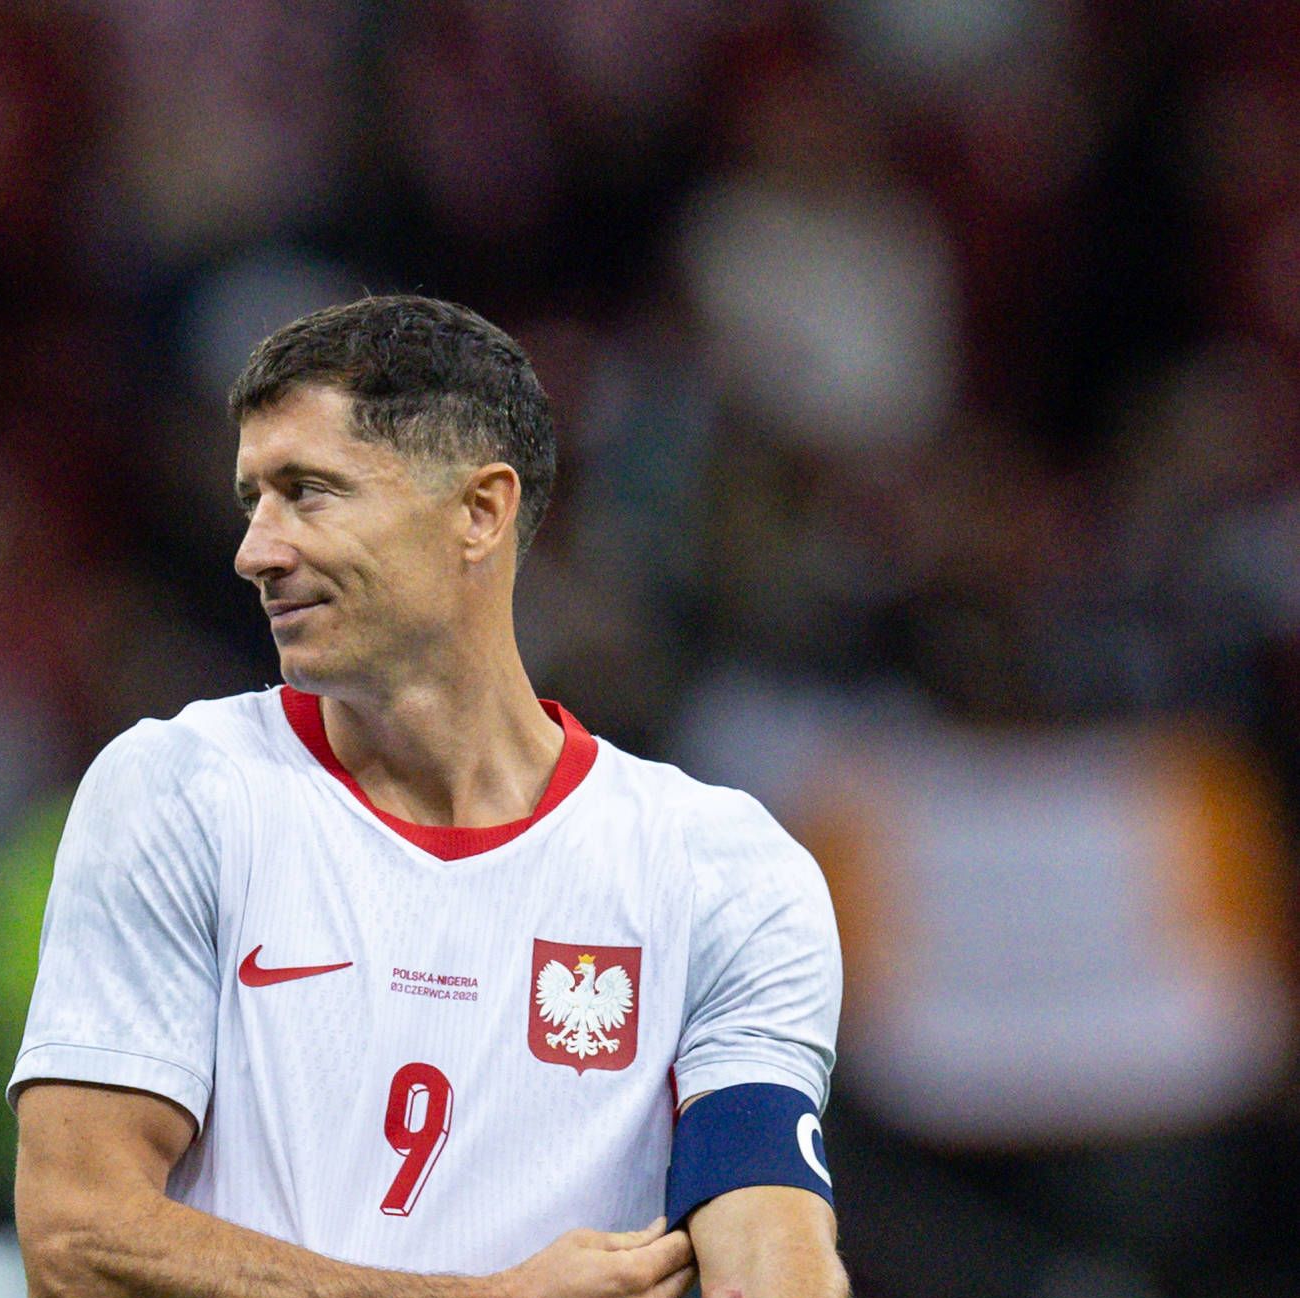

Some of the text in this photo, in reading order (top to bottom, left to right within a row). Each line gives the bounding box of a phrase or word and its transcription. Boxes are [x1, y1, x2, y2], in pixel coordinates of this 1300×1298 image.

[393, 968, 478, 987] POLSKA-NIGERIA
[390, 982, 403, 992] 03
[404, 984, 451, 1000] CZERWCA
[379, 1062, 454, 1217] 9
